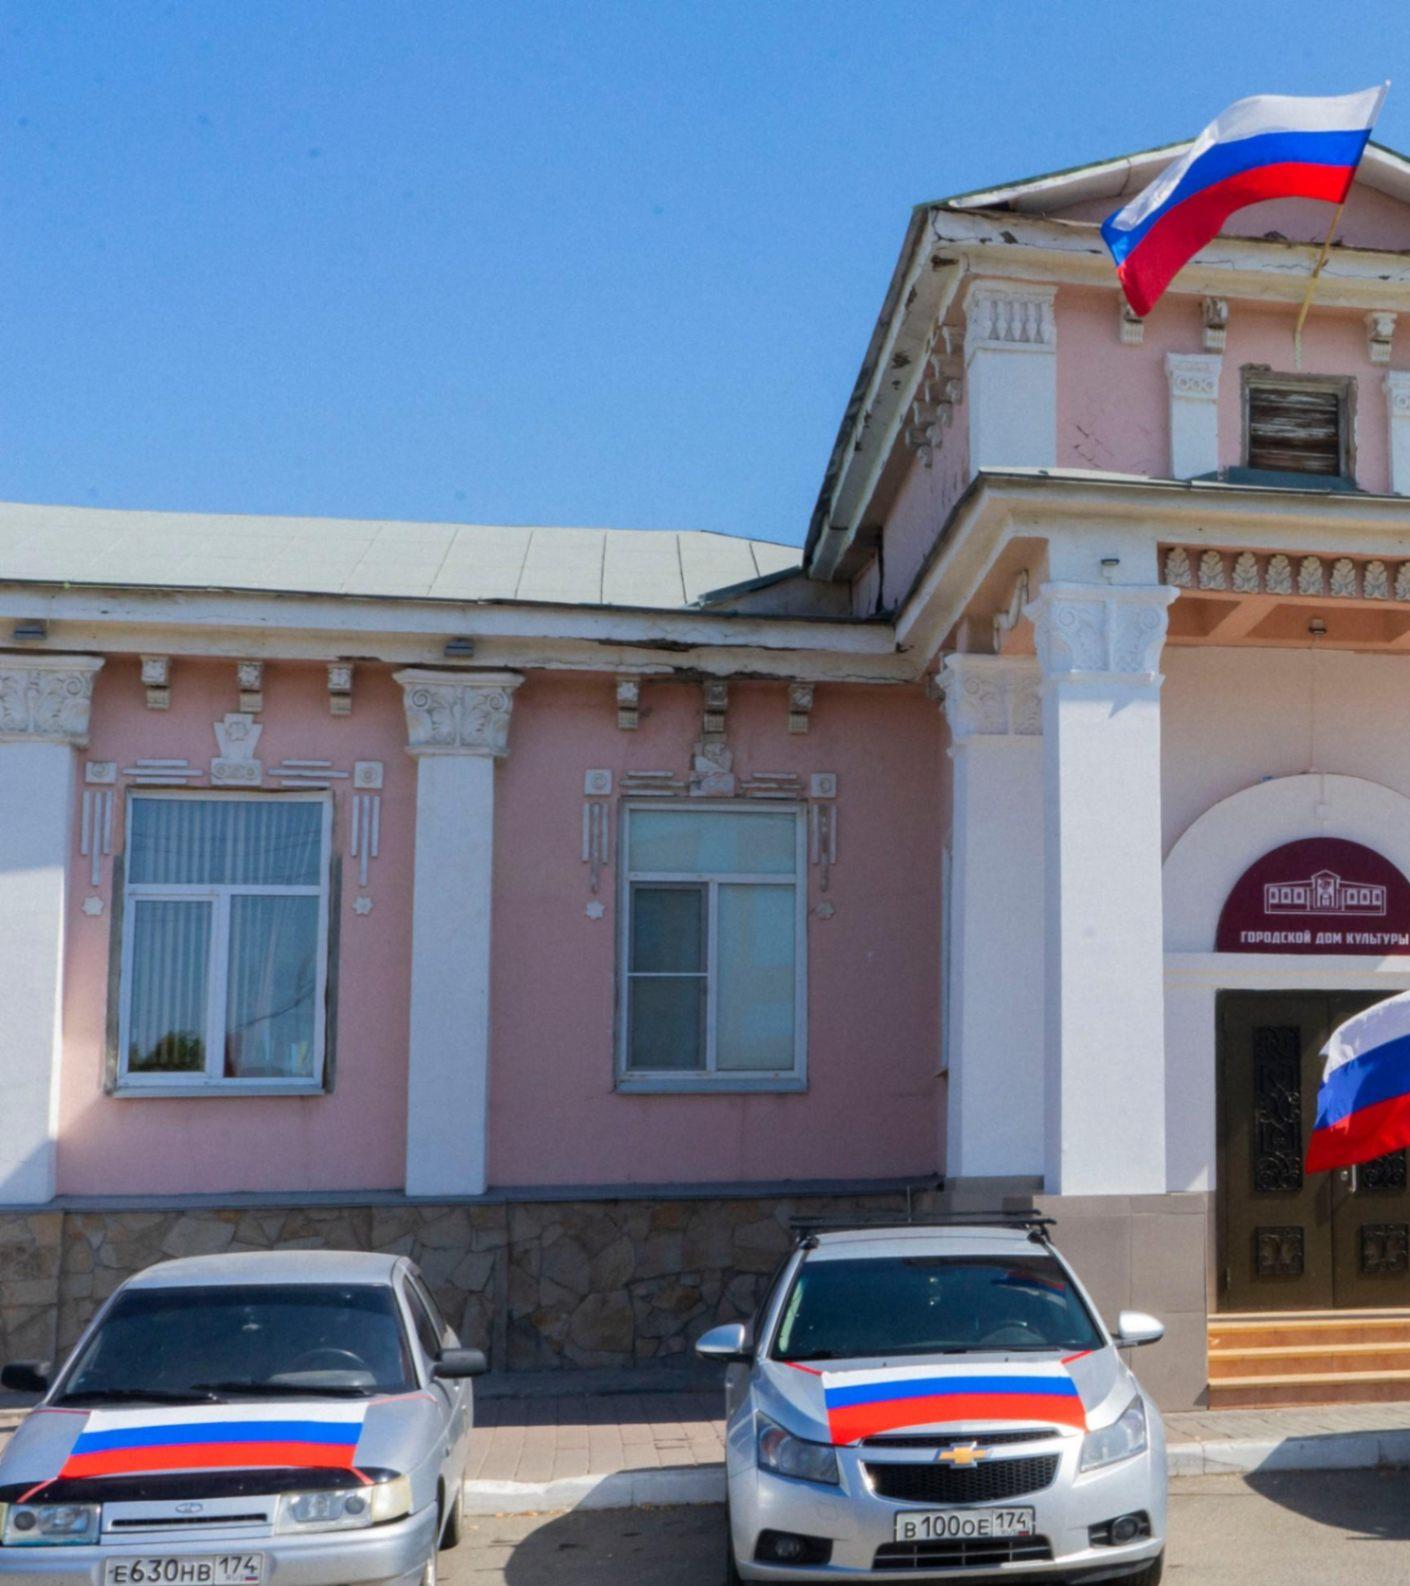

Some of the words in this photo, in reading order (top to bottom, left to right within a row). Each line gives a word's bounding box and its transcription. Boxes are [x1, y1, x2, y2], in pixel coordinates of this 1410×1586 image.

[1240, 930, 1311, 944] ГОРОДСКОЙ
[1315, 932, 1342, 945] ДОМ
[1346, 932, 1410, 945] КУЛЬТУРЫ
[995, 1512, 1026, 1528] 174
[114, 1558, 212, 1583] Е630НВ
[219, 1556, 259, 1574] 174
